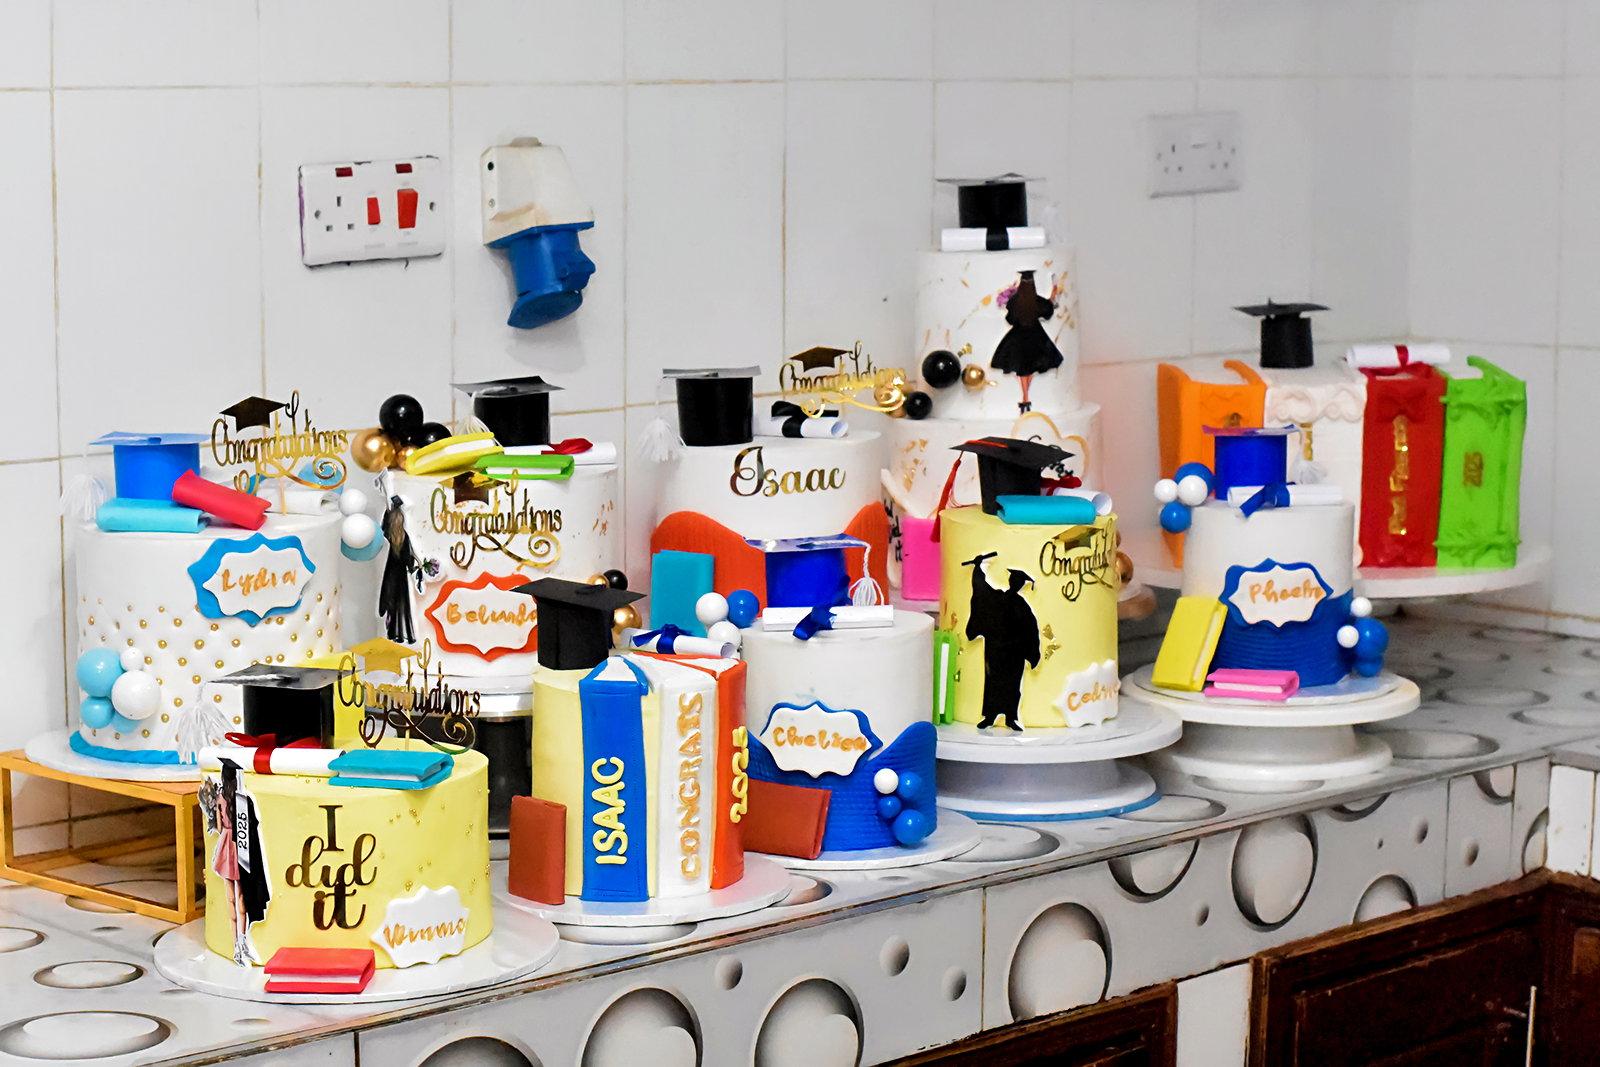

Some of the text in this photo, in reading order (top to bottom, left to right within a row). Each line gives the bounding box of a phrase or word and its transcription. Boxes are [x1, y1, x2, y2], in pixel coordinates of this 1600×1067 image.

[211, 389, 349, 497] Congratulations
[730, 446, 846, 498] Isaac
[430, 469, 563, 570] Congratulations
[221, 567, 296, 596] Lydia
[446, 602, 537, 626] Belinda
[337, 637, 481, 756] Congratulations
[591, 757, 628, 865] ISAAC
[676, 691, 704, 880] CONGRATS
[237, 812, 248, 850] 2025
[319, 804, 344, 852] I
[285, 833, 377, 888] did
[313, 881, 366, 931] it
